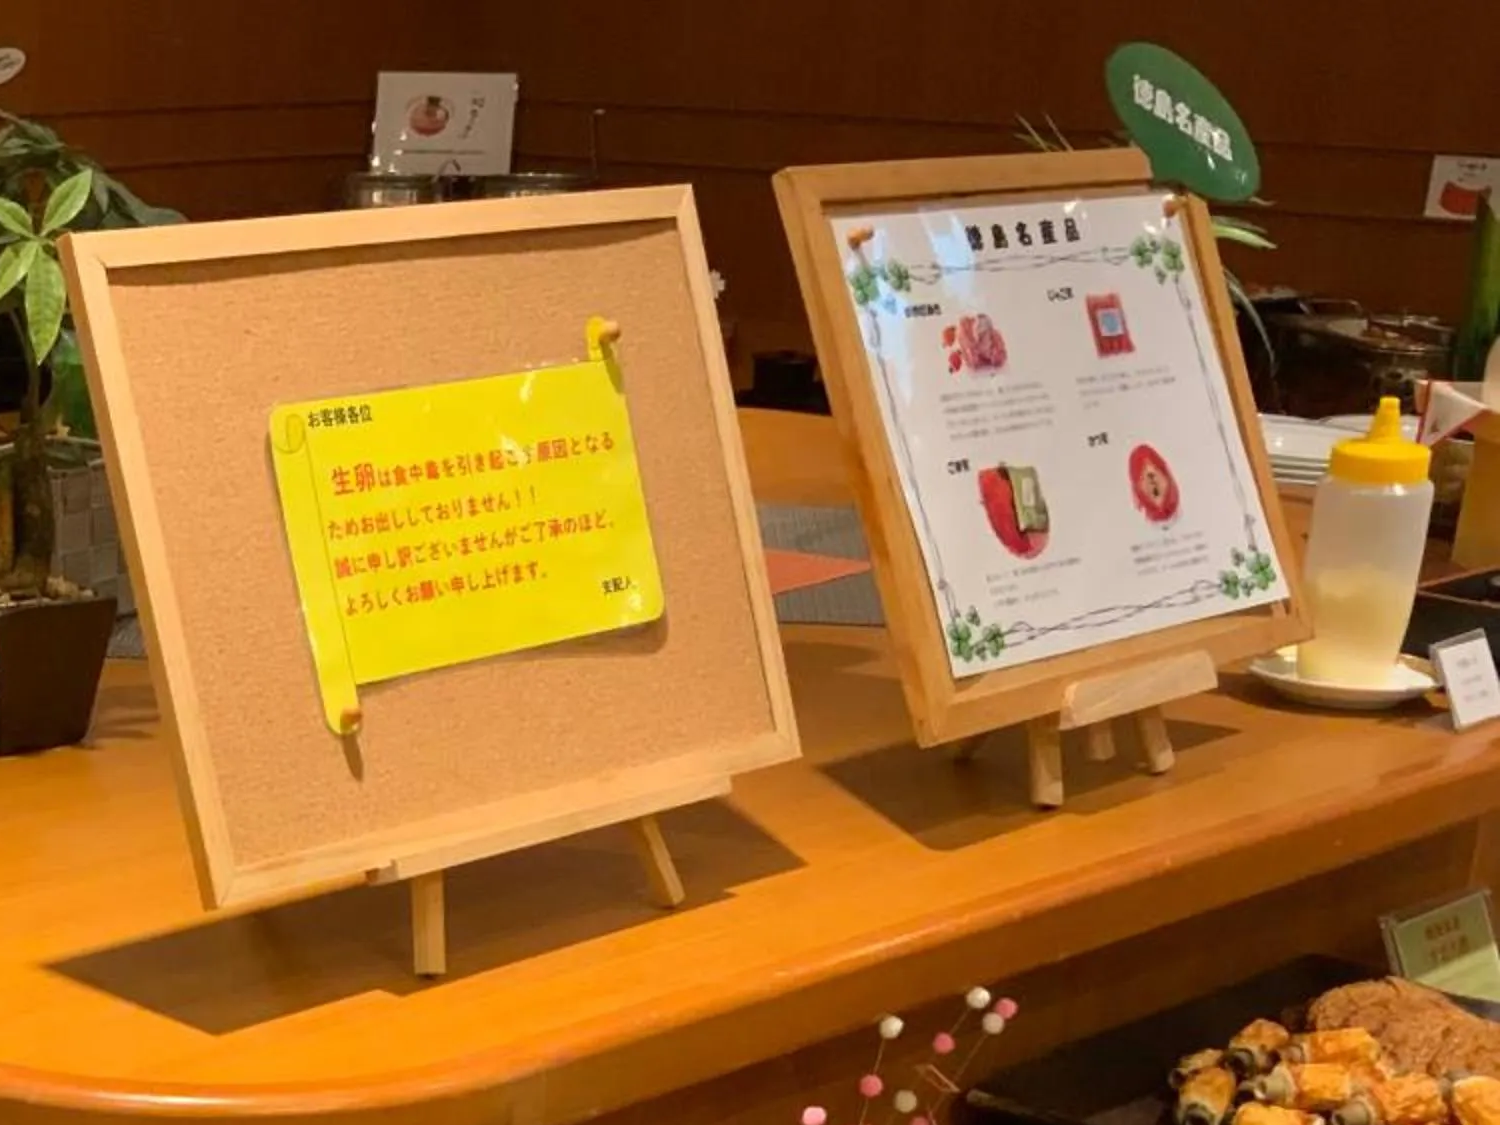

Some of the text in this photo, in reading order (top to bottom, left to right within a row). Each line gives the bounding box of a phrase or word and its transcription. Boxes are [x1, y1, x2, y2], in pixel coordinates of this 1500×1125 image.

[308, 404, 373, 428] お客様各位
